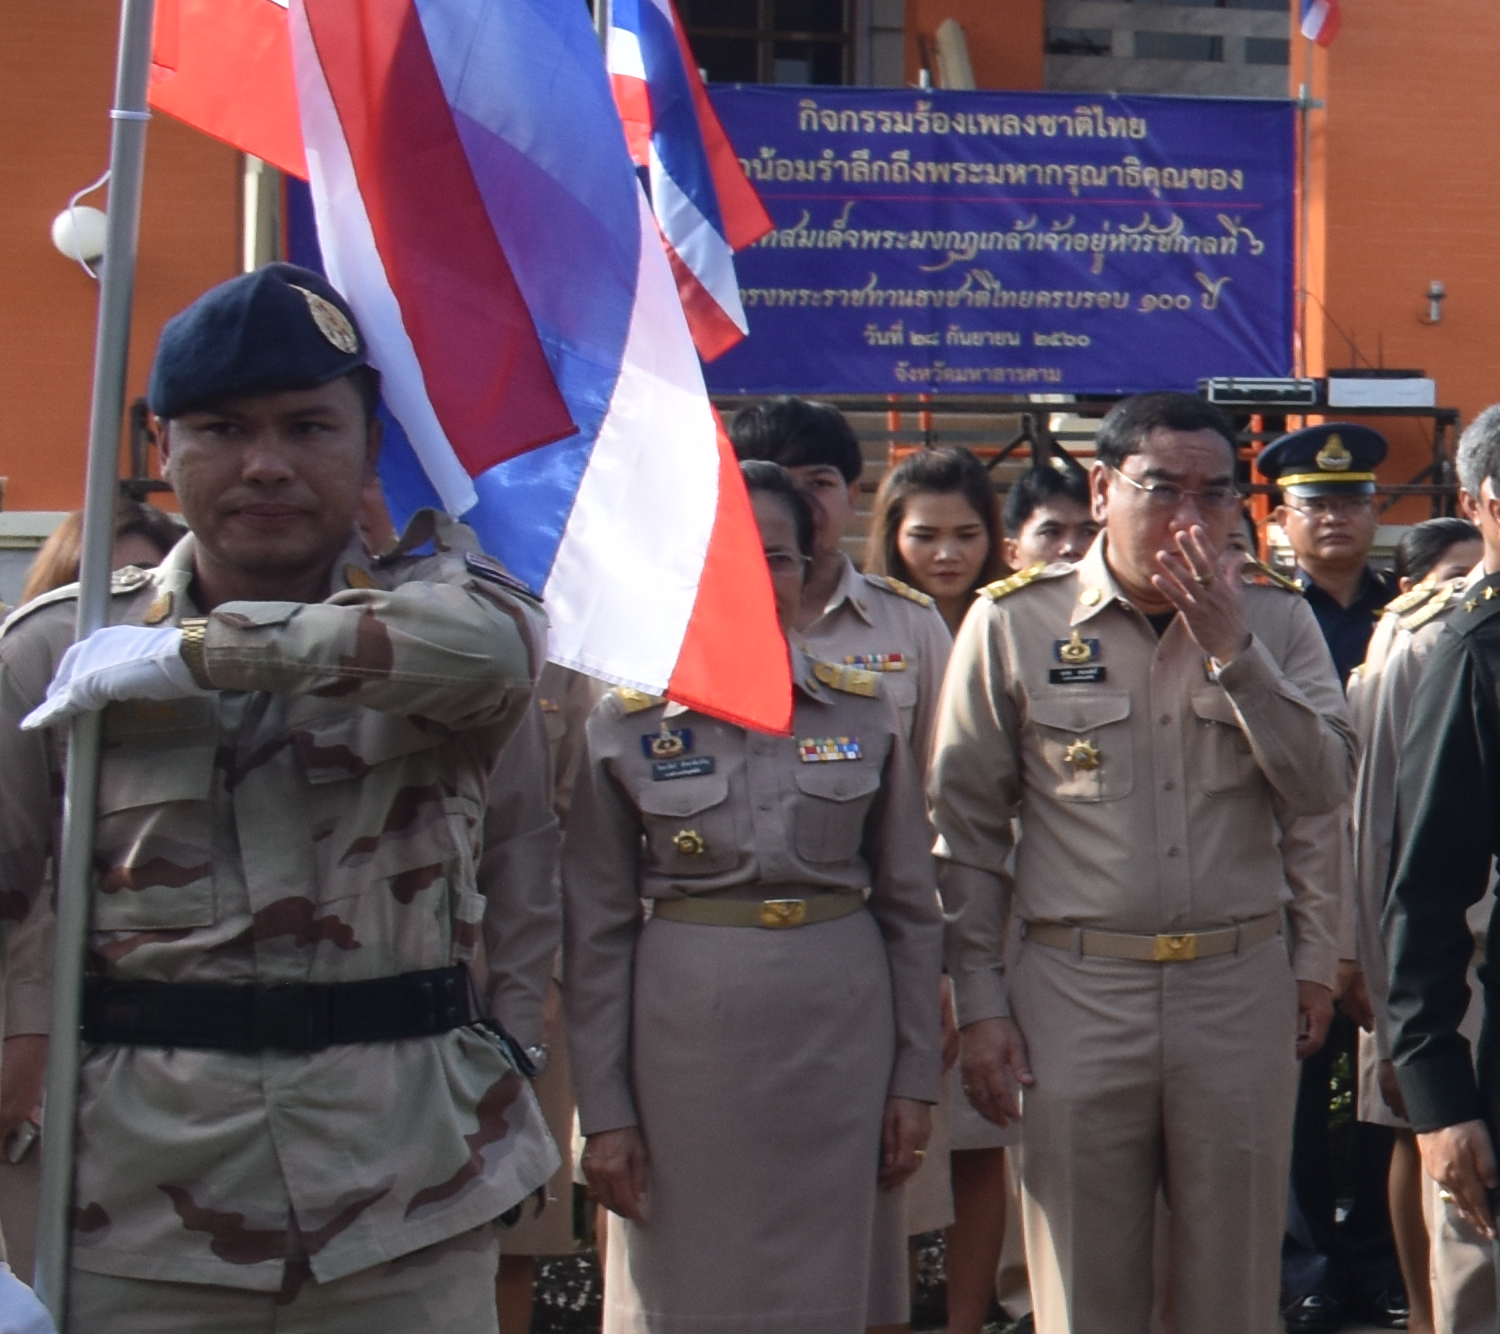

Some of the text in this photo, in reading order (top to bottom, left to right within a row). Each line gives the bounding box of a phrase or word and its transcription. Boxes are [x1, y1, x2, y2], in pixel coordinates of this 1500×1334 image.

[799, 98, 1147, 139] กิจกรรมร้องเพลงชาติไทย
[1137, 292, 1192, 312] ๑๐๐
[1194, 271, 1232, 310] ปี
[863, 320, 1091, 346] วันที่ ๒๘ กันยายน ๒๕๖๐
